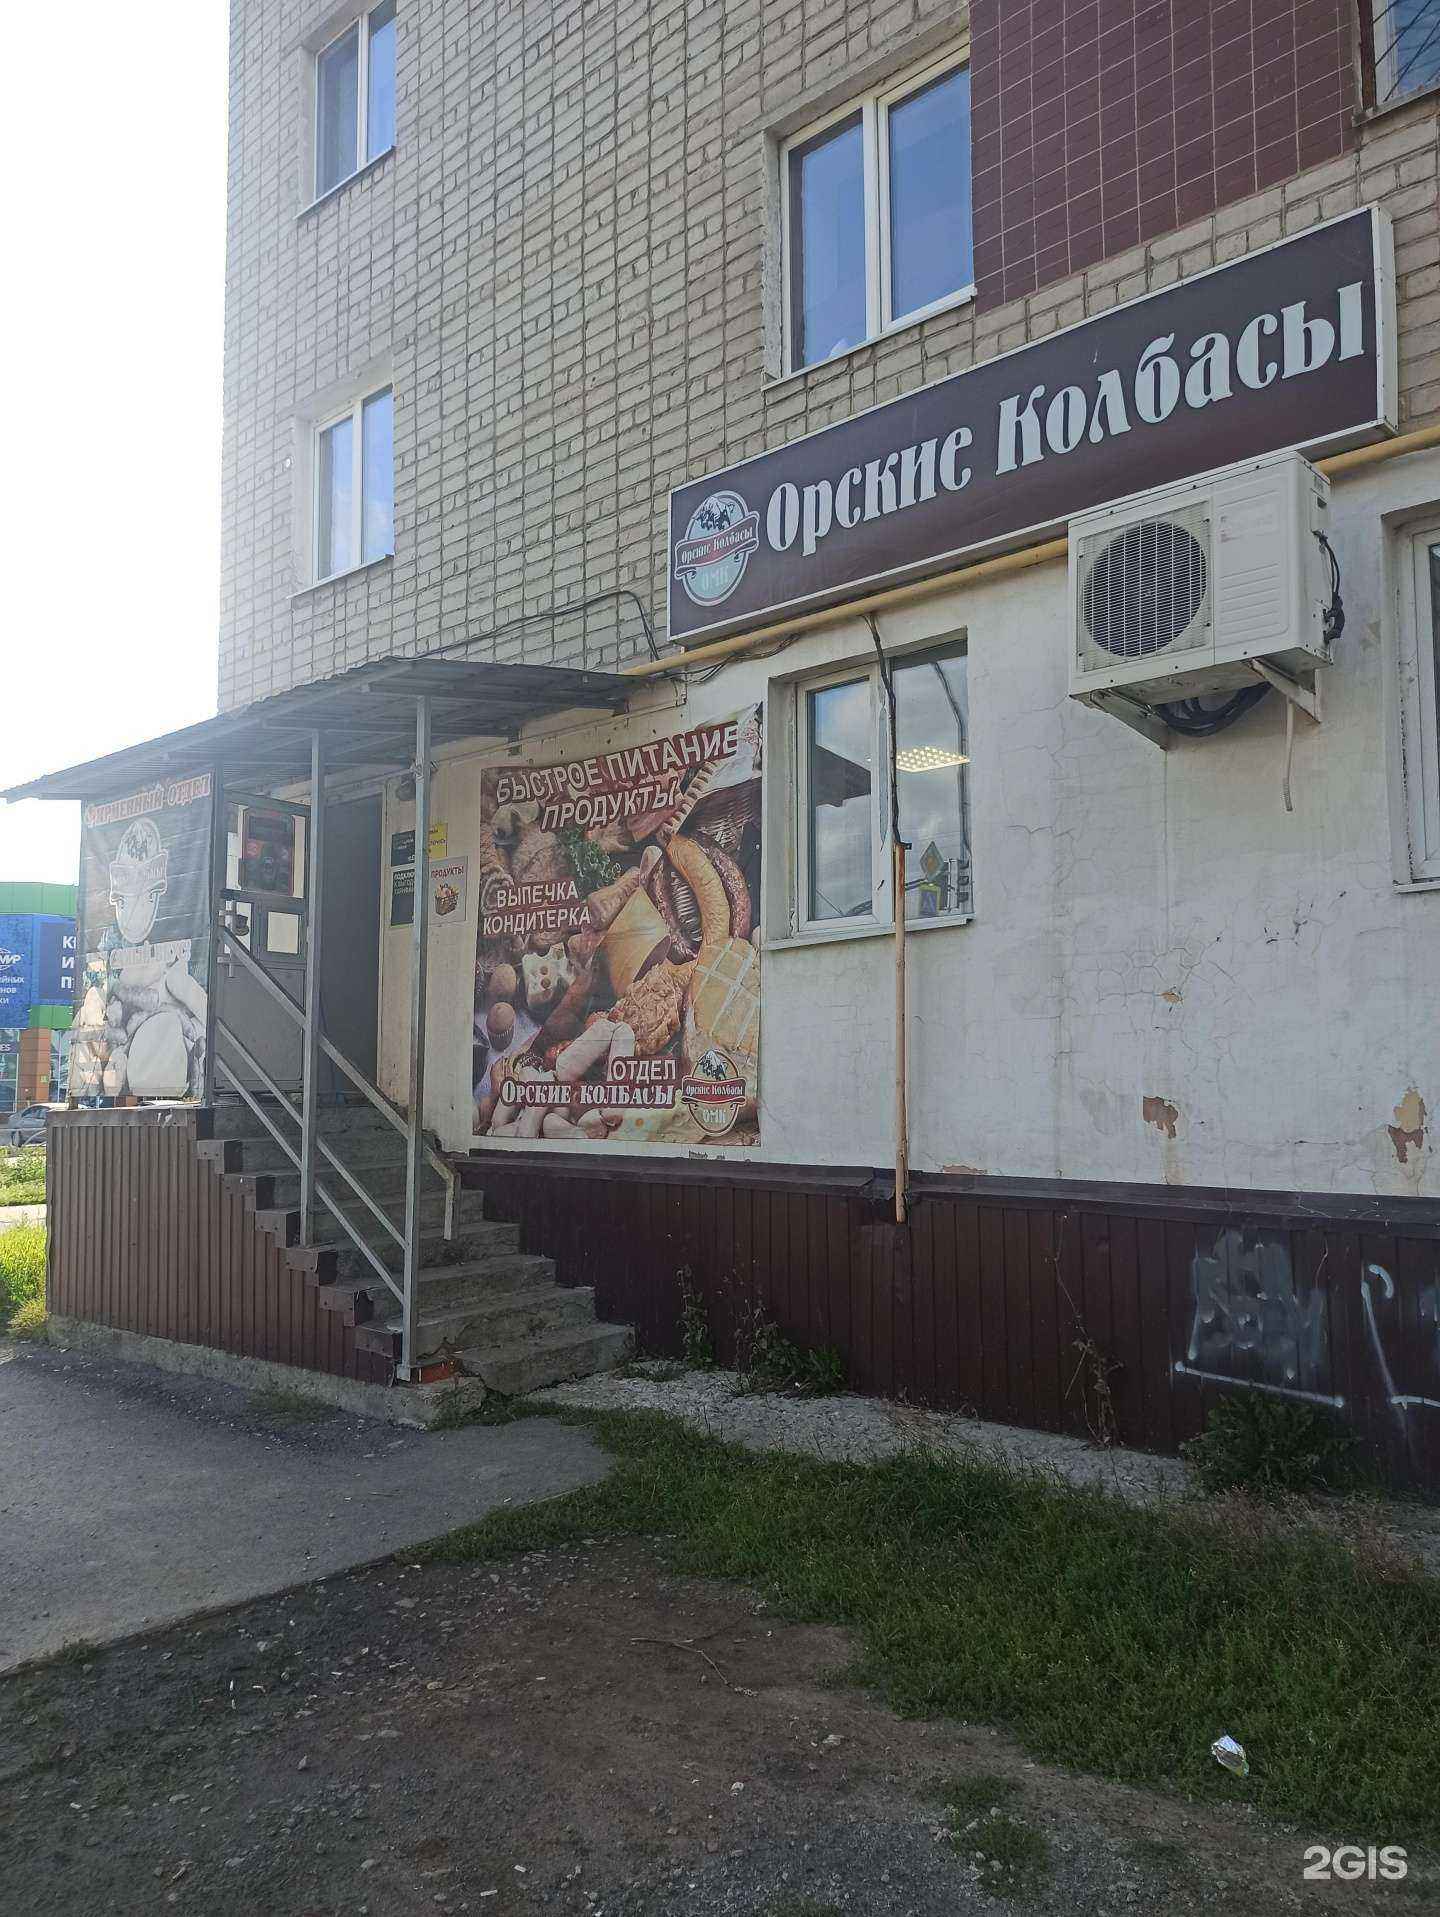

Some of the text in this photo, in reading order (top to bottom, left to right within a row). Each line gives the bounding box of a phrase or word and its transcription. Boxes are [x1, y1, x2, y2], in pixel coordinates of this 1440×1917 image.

[766, 281, 1365, 557] Орские Колбасы
[713, 526, 754, 552] Колбасы
[496, 725, 738, 803] БЫСТРОЕ ПИТАНИЕ
[540, 778, 678, 830] ПРОДУКТЫ
[430, 866, 464, 879] ПРОДУКТЫ
[496, 881, 579, 908] ВЫПЕЧКА
[483, 906, 592, 936] КОНДИТЕРКА
[612, 1059, 677, 1083] ОТДЕЛ
[711, 1085, 743, 1095] Колбасы
